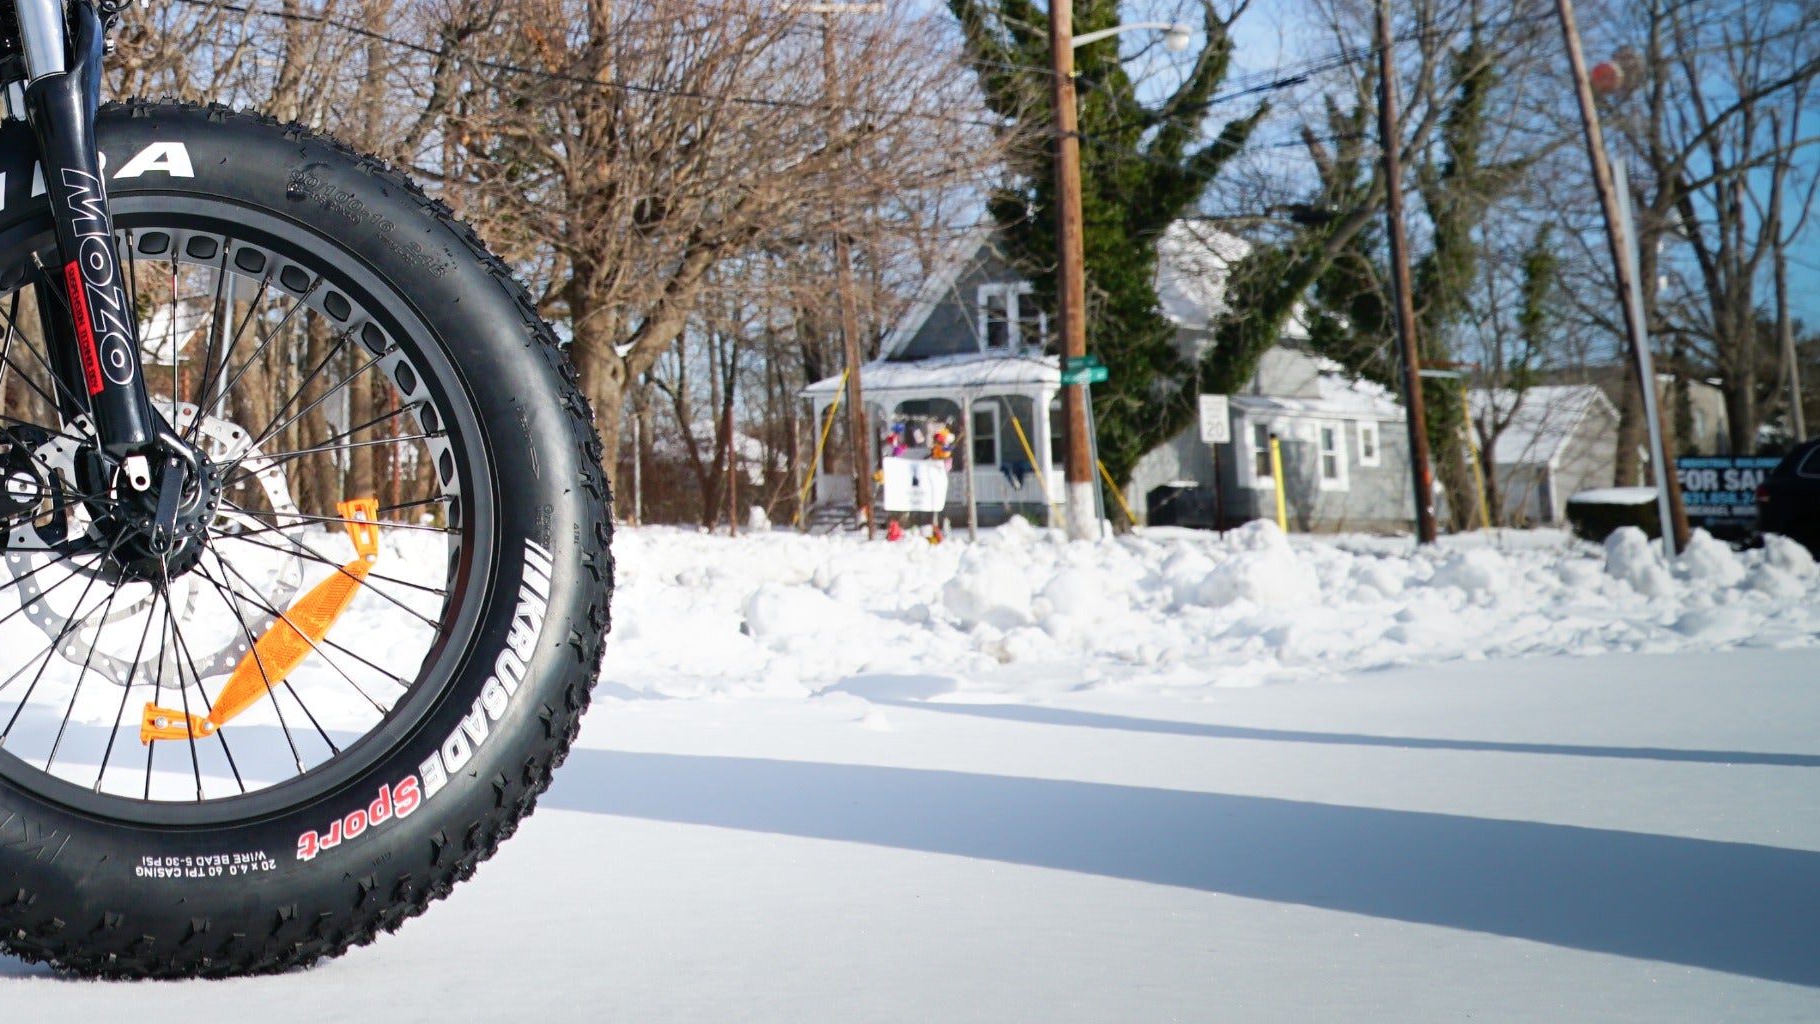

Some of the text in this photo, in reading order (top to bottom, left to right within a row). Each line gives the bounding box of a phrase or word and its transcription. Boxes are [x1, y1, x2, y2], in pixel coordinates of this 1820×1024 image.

[60, 168, 135, 385] MOZO
[1675, 469, 1719, 491] FOR
[296, 587, 547, 861] KRUSADE Sport
[142, 851, 267, 867] WIRE BEAD 5-30 PSI
[261, 859, 276, 872] 20
[135, 865, 182, 878] CASING
[185, 866, 206, 878] TPI
[208, 866, 223, 877] 60
[230, 863, 248, 876] 4.0
